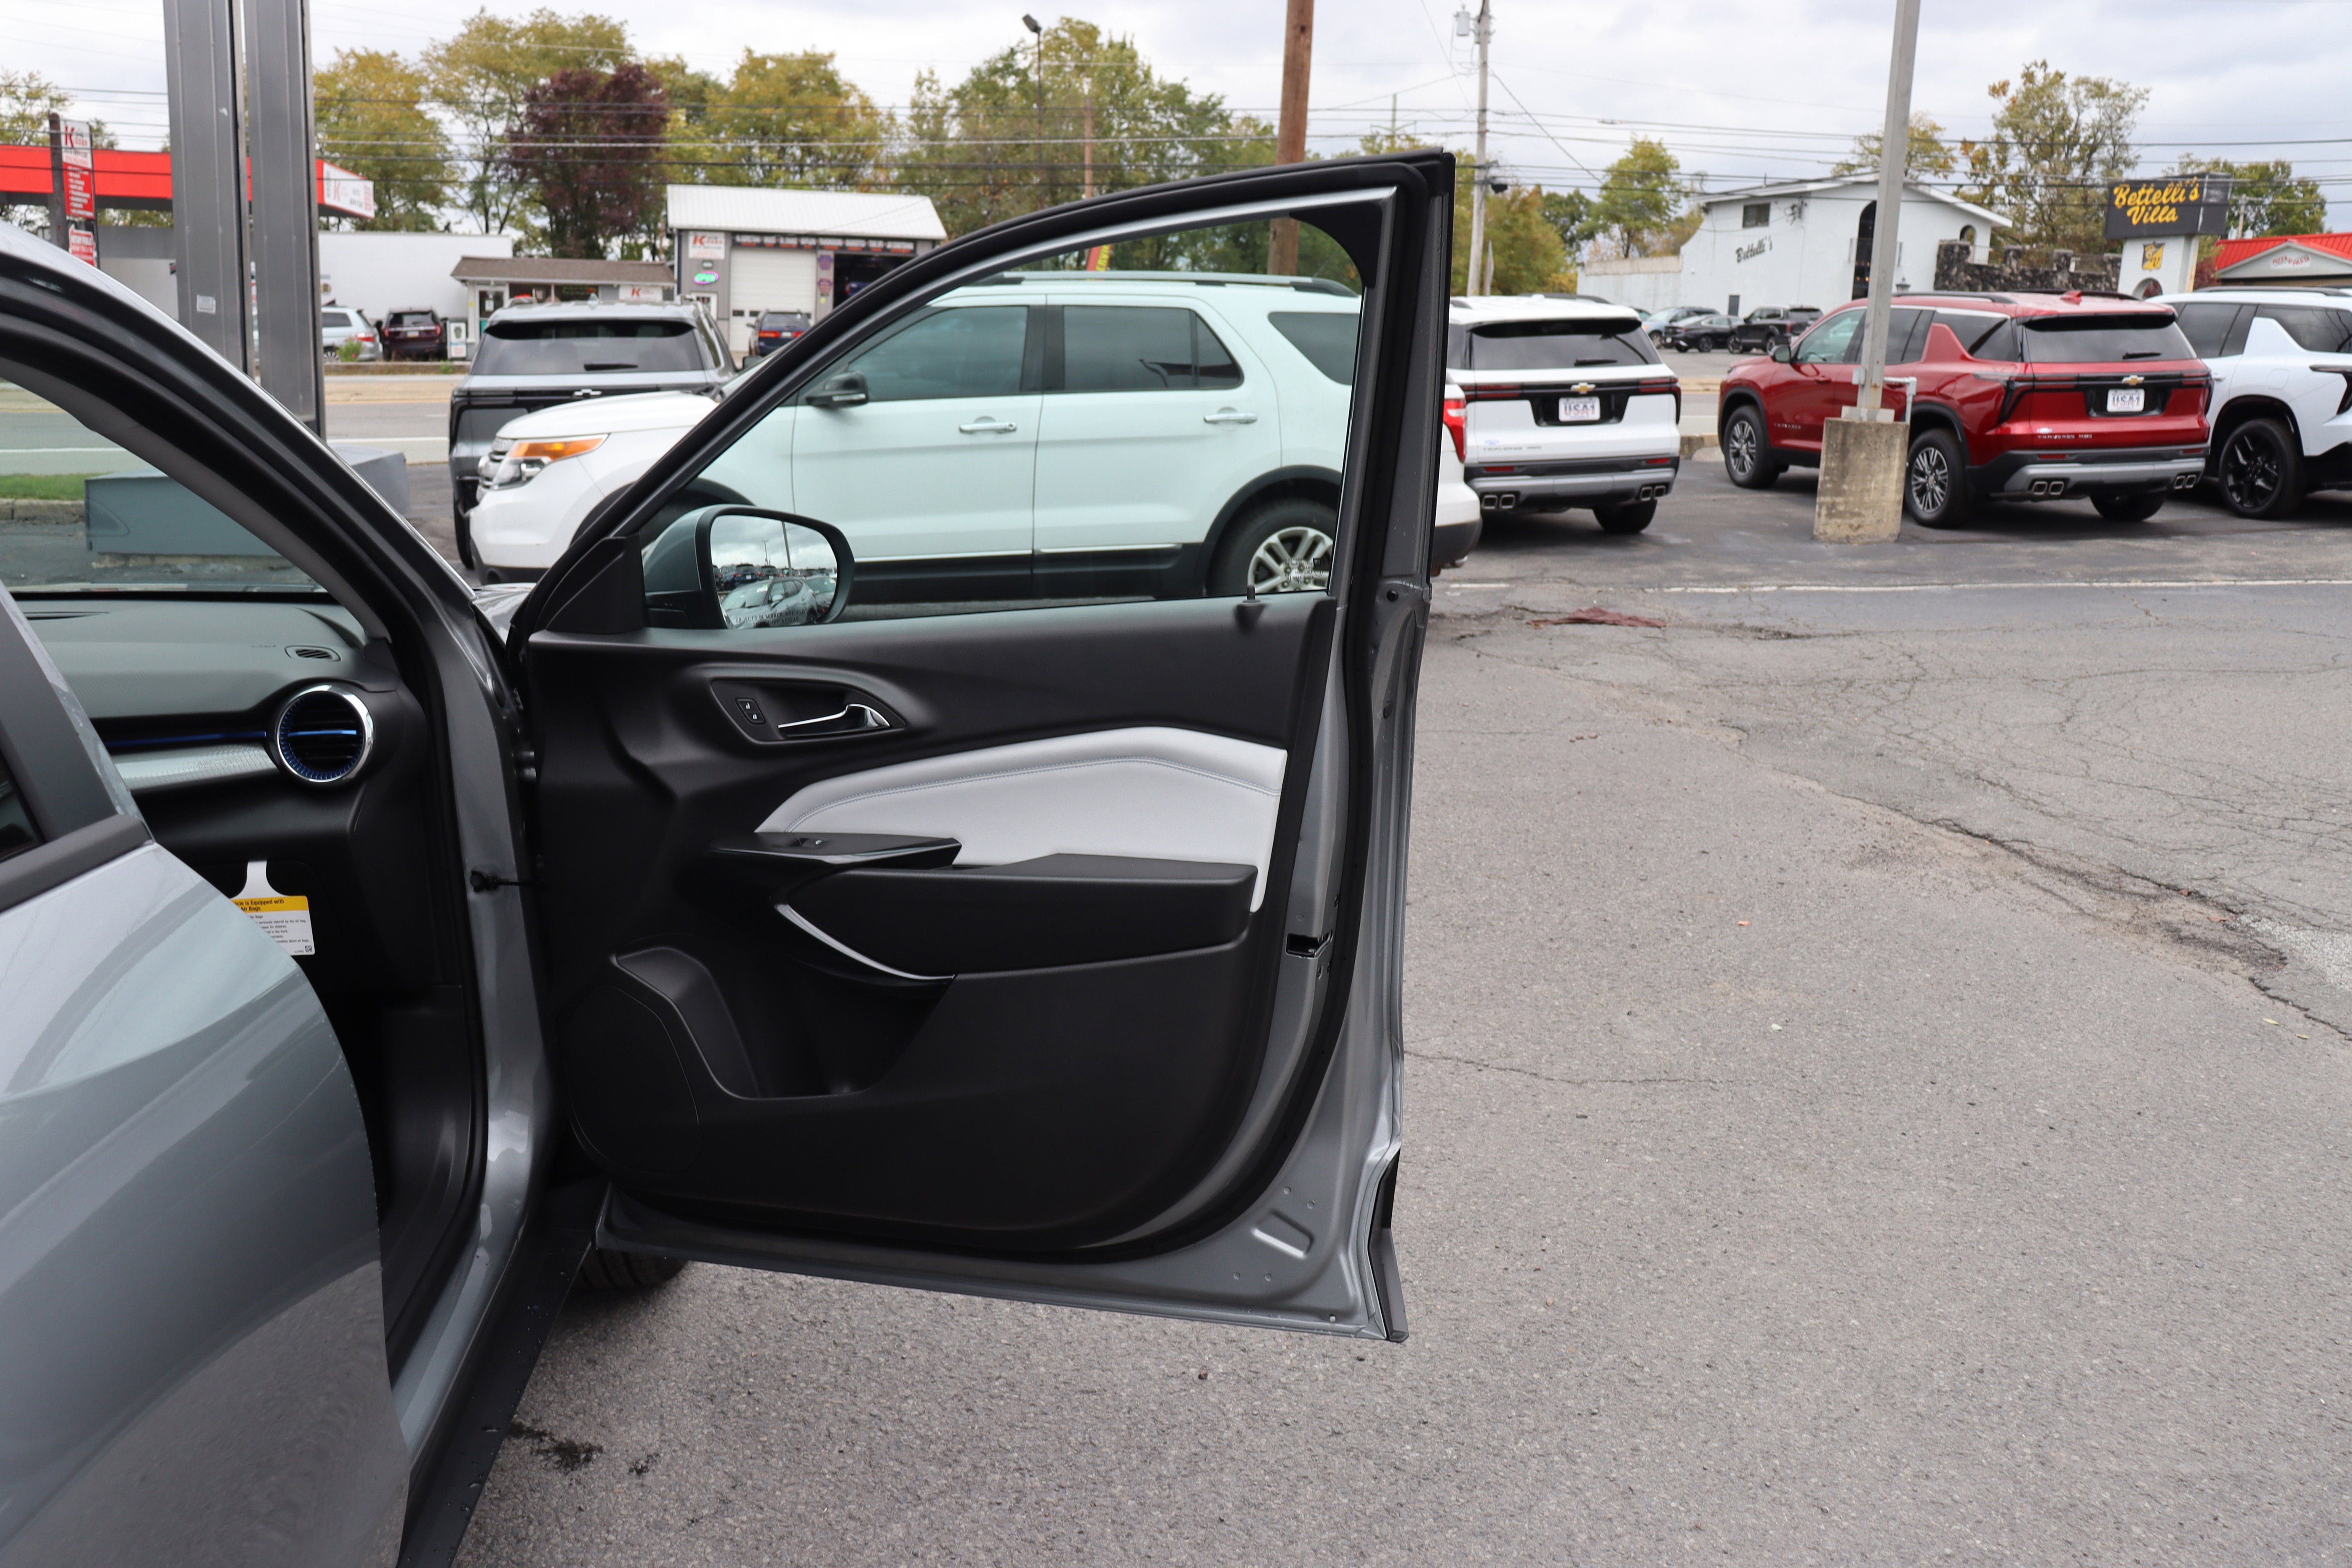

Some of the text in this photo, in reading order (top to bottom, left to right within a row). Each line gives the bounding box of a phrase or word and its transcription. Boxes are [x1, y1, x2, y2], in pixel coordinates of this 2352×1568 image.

[2114, 176, 2200, 209] Bettelli's
[2127, 205, 2178, 225] Villa
[1735, 234, 1773, 263] Bettelli's
[1564, 403, 1595, 416] USA1
[2113, 394, 2140, 406] USA1
